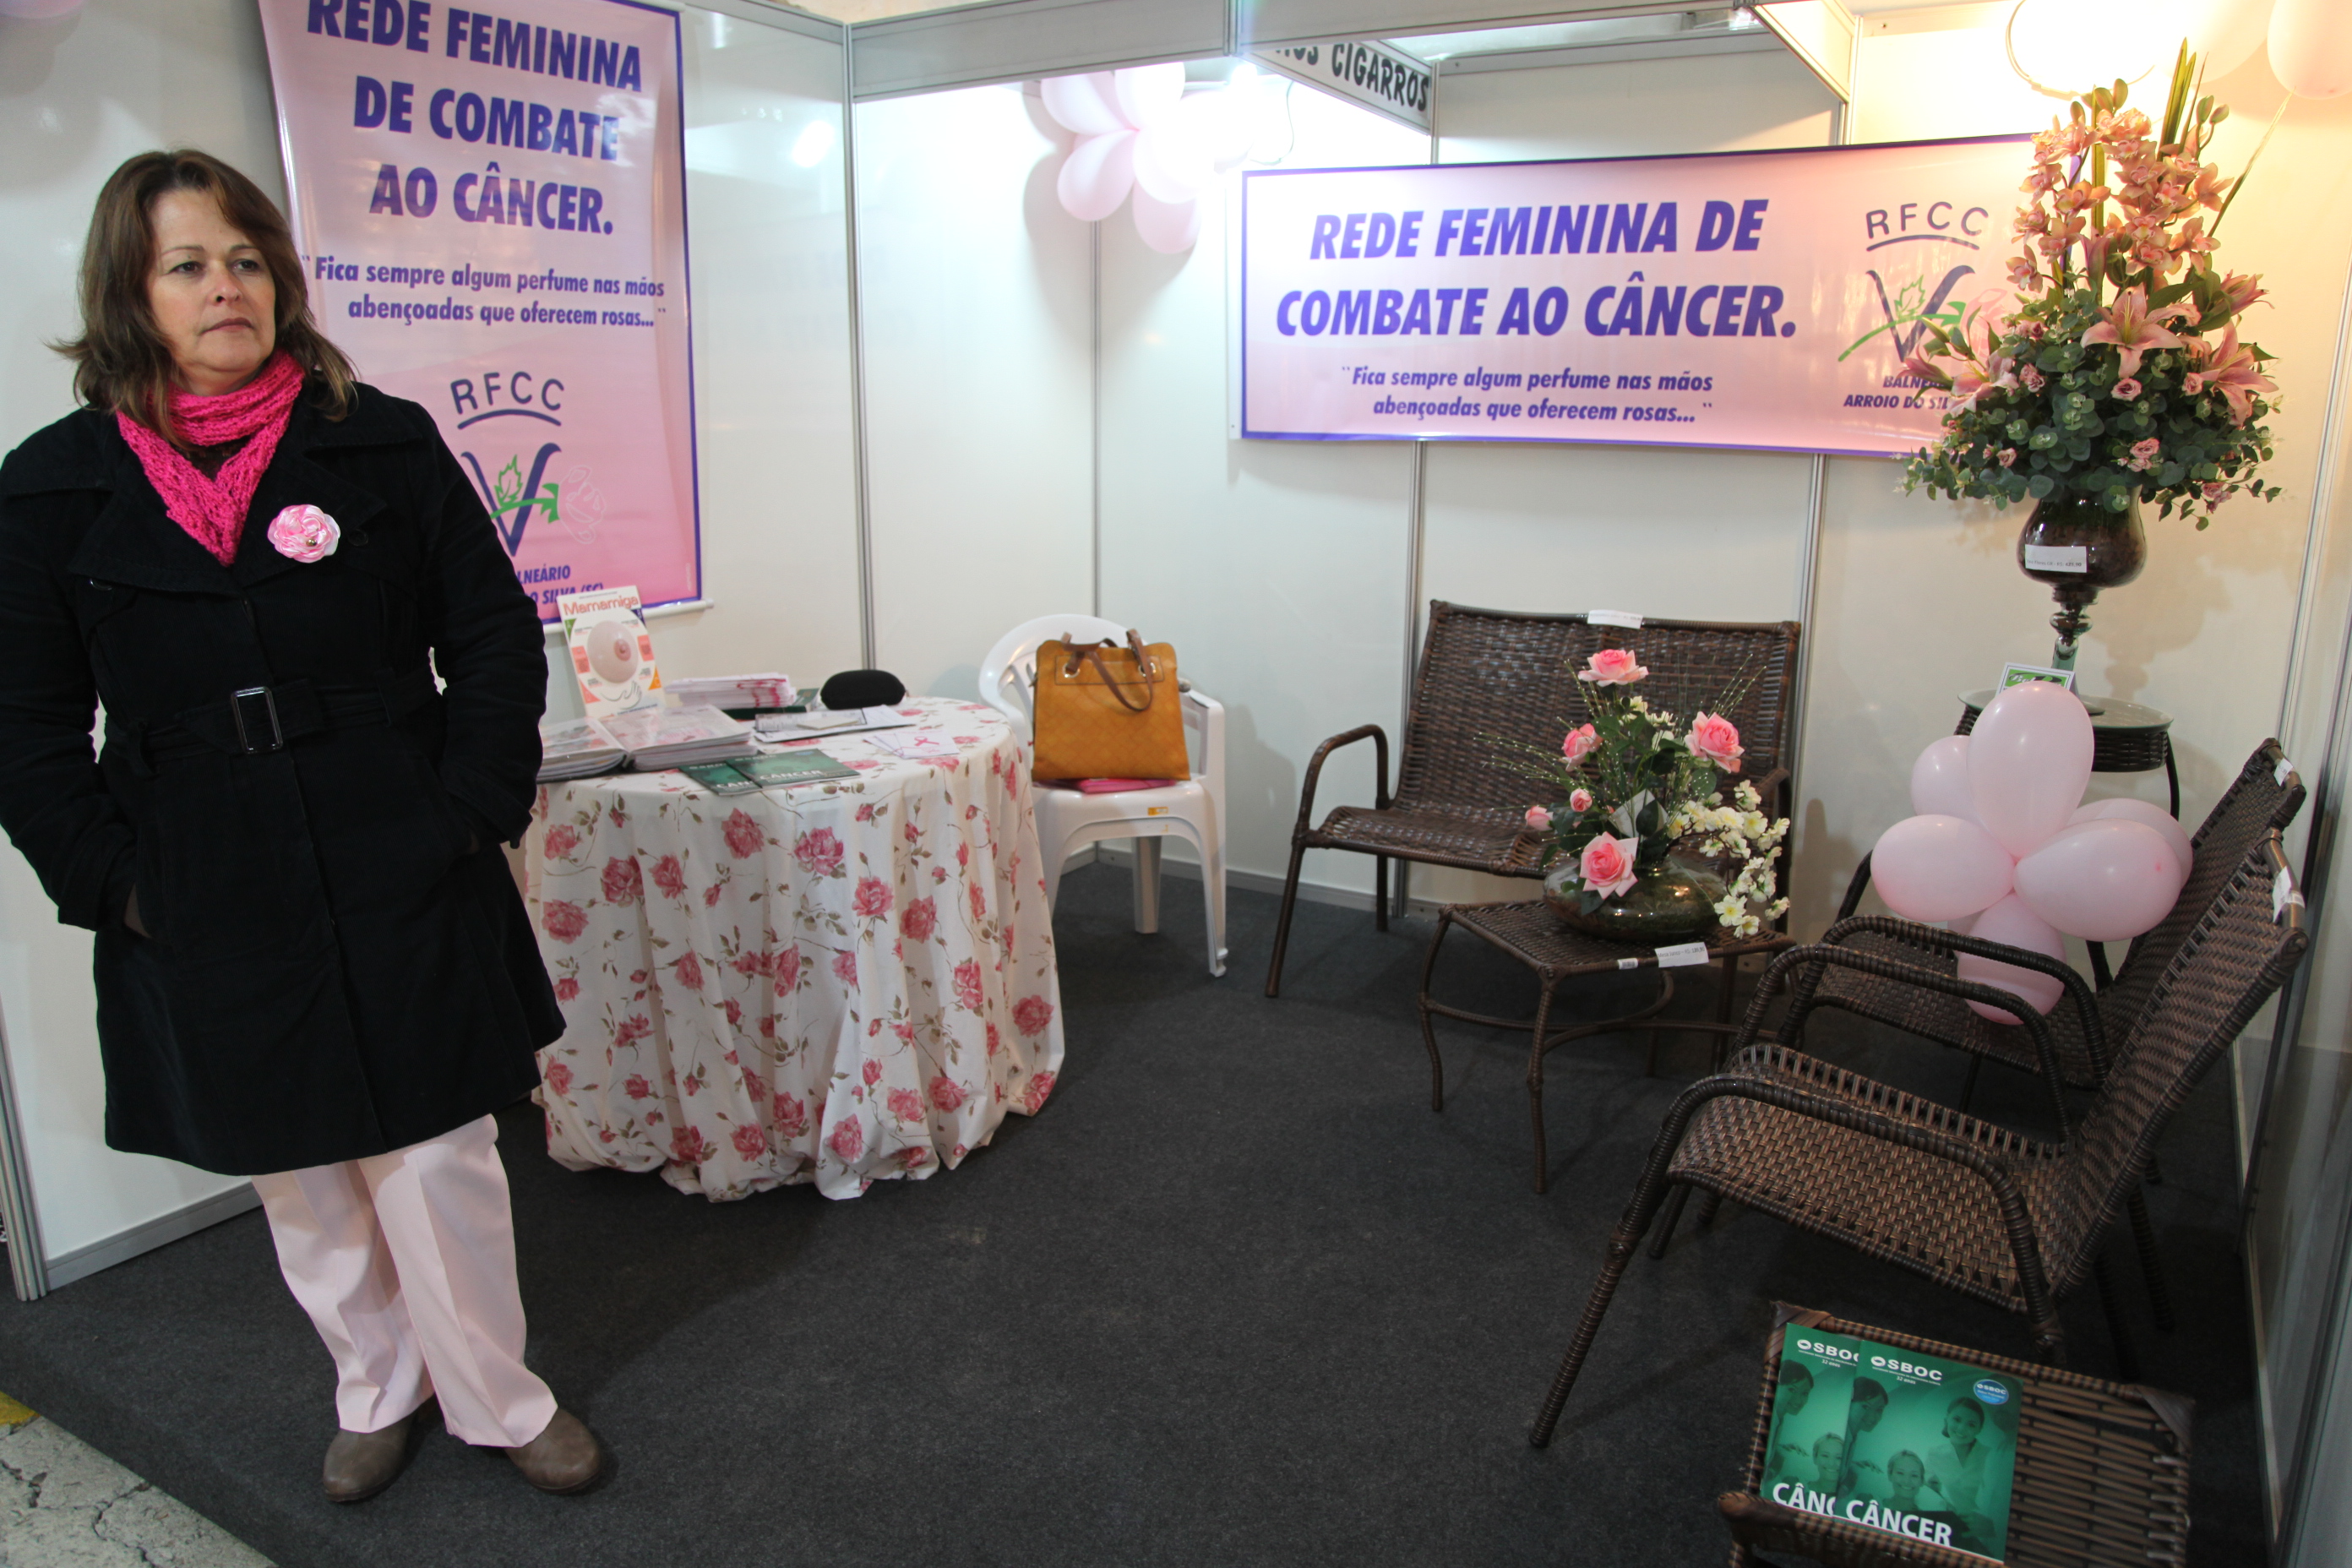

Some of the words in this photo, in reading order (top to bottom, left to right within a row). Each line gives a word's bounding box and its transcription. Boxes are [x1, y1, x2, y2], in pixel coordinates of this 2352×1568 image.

[307, 0, 430, 52] REDE
[446, 8, 642, 92] FEMININA
[1331, 43, 1429, 112] CIGARROS
[353, 76, 414, 133] DE
[429, 88, 618, 161] COMBATE
[369, 163, 438, 218] AO
[453, 161, 613, 235] CÂNCER.
[1309, 210, 1424, 259] REDE
[1435, 202, 1678, 256] FEMININA
[1695, 199, 1769, 252] DE
[1865, 202, 1989, 239] RFCC
[366, 264, 445, 289] sempre
[451, 263, 511, 291] algum
[517, 268, 589, 296] perfume
[593, 278, 621, 295] nas
[624, 277, 664, 297] mãos
[348, 293, 474, 325] abençoadas
[480, 307, 514, 326] que
[520, 302, 597, 326] oferecem
[1277, 288, 1489, 335] COMBATE
[1497, 286, 1569, 335] AO
[1584, 271, 1796, 338] CÂNCER.
[450, 371, 564, 414] RFCC
[1391, 369, 1458, 389] sempre
[1463, 367, 1522, 391] algum
[1527, 368, 1610, 391] perfume
[1616, 373, 1652, 389] nas
[1658, 369, 1712, 391] mãos
[1882, 375, 1945, 388] BALNE
[1374, 395, 1481, 422] abençoadas
[1486, 404, 1522, 423] que
[1527, 400, 1617, 422] oferecem
[1843, 395, 1899, 407] ARROIO
[1903, 396, 1925, 409] DO
[1928, 396, 1948, 410] SIL
[516, 563, 571, 585] LNEÁRIO
[1772, 1483, 1836, 1517] CÂN
[1846, 1500, 1952, 1548] CÂNCER
